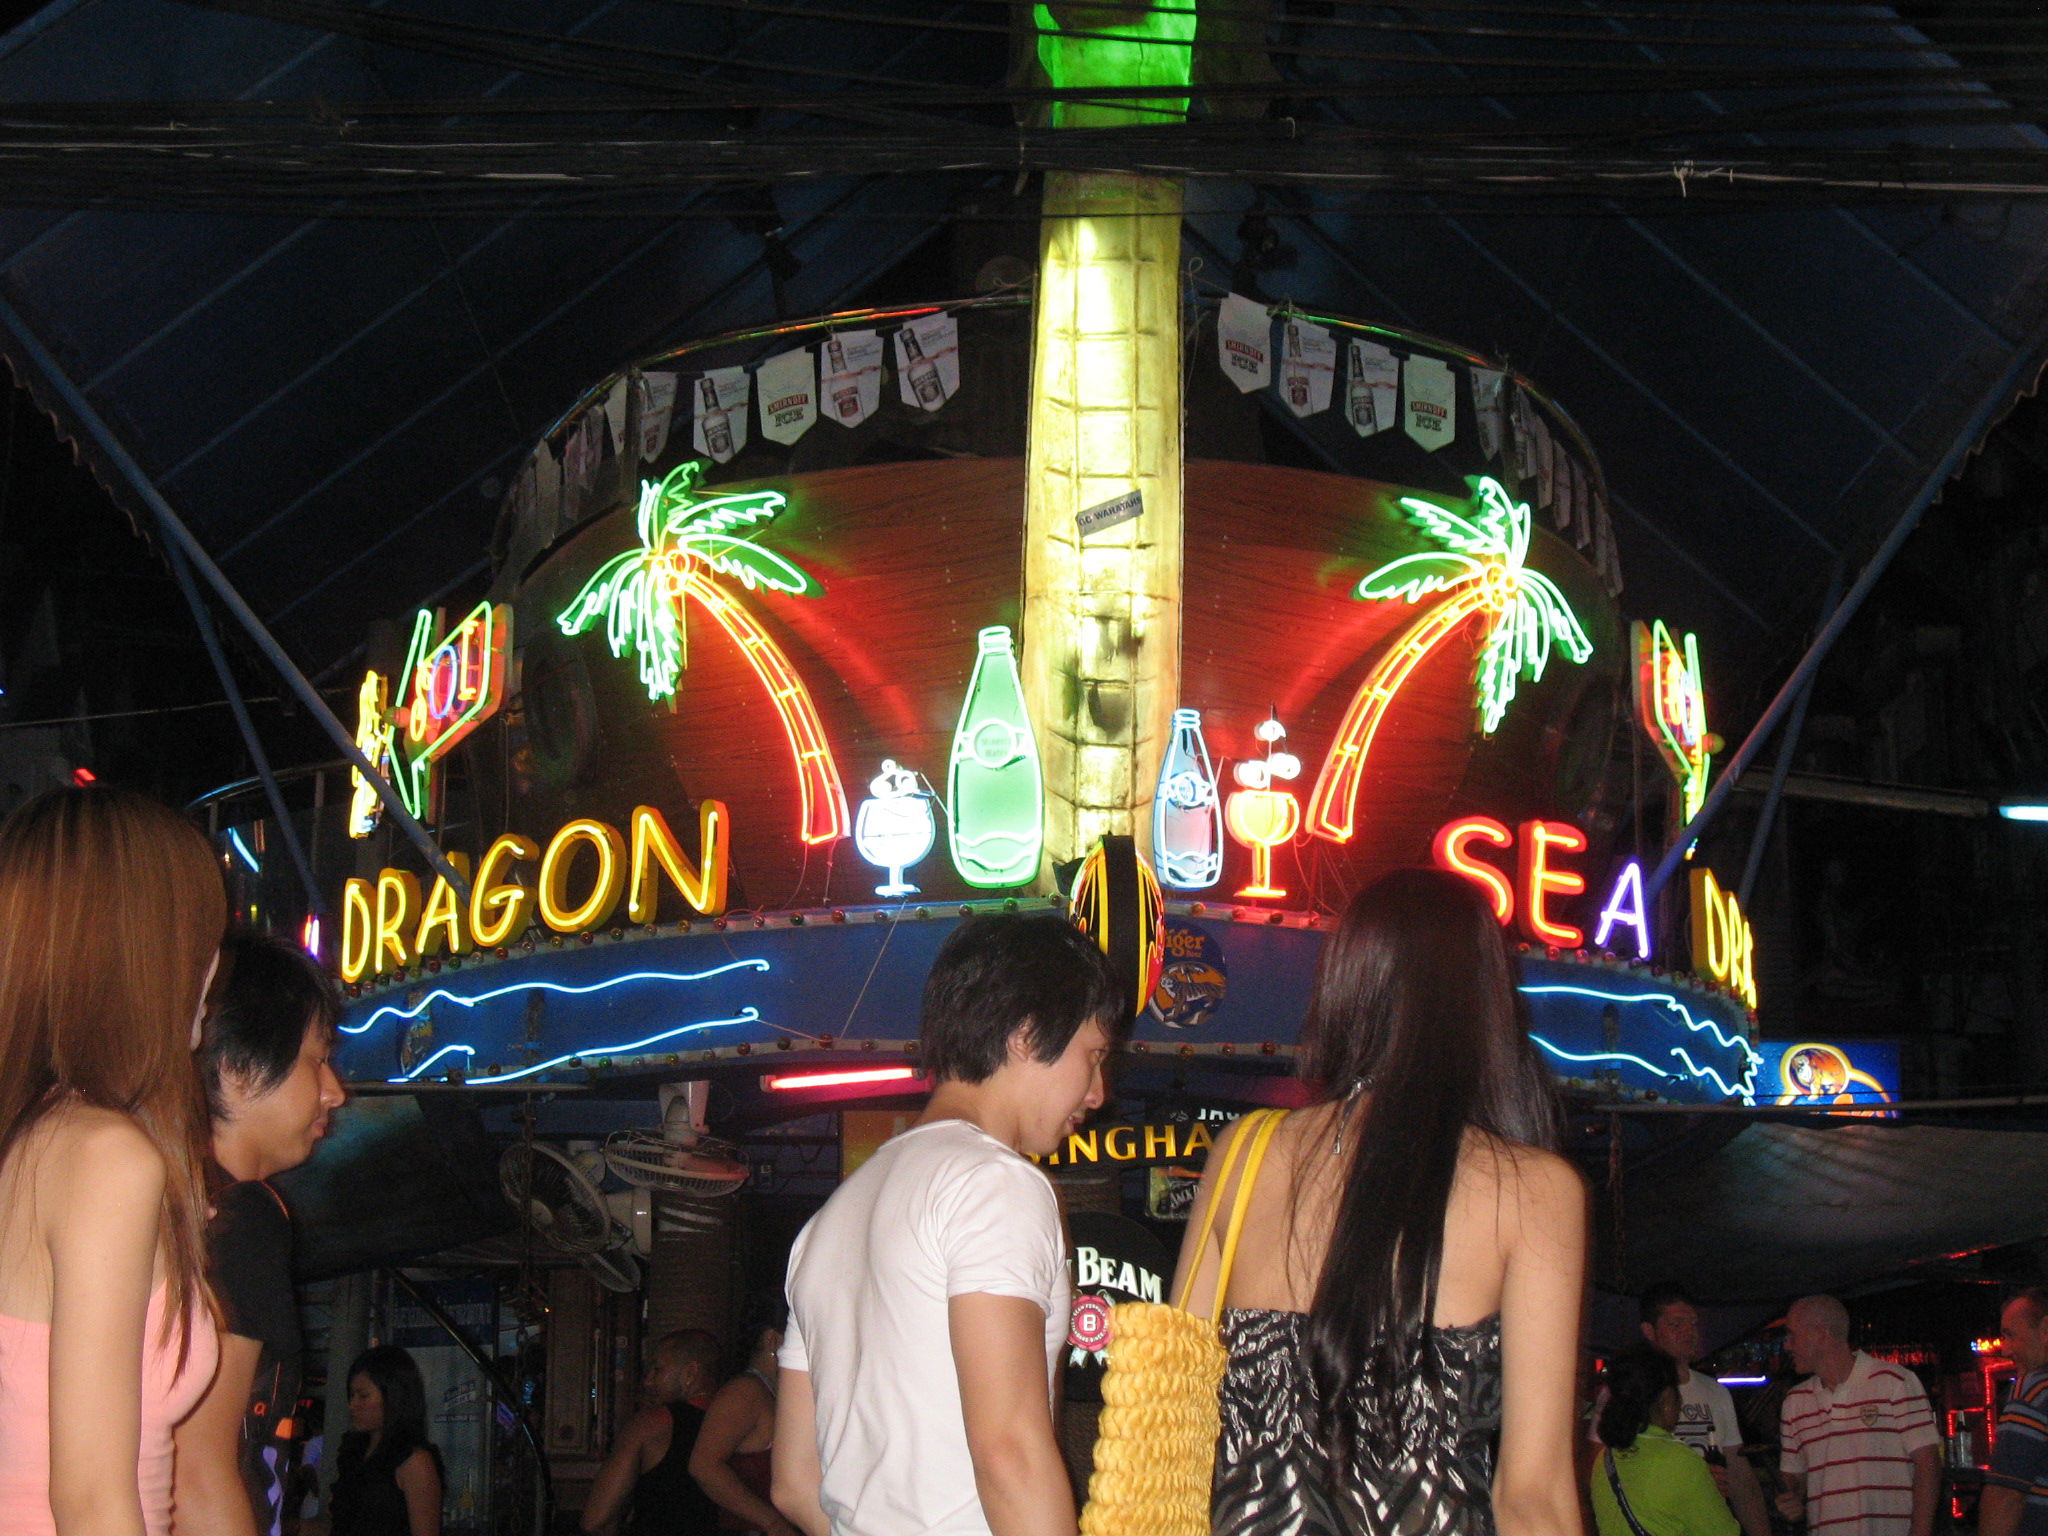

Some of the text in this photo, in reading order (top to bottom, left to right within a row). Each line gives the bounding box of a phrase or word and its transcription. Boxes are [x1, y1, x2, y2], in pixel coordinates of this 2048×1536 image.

[341, 800, 730, 983] DRAGON
[1432, 815, 1651, 962] SEA
[1165, 928, 1206, 957] iger
[1025, 1122, 1214, 1167] NGHA
[1076, 1246, 1162, 1304] BEAM
[1083, 1313, 1097, 1332] B
